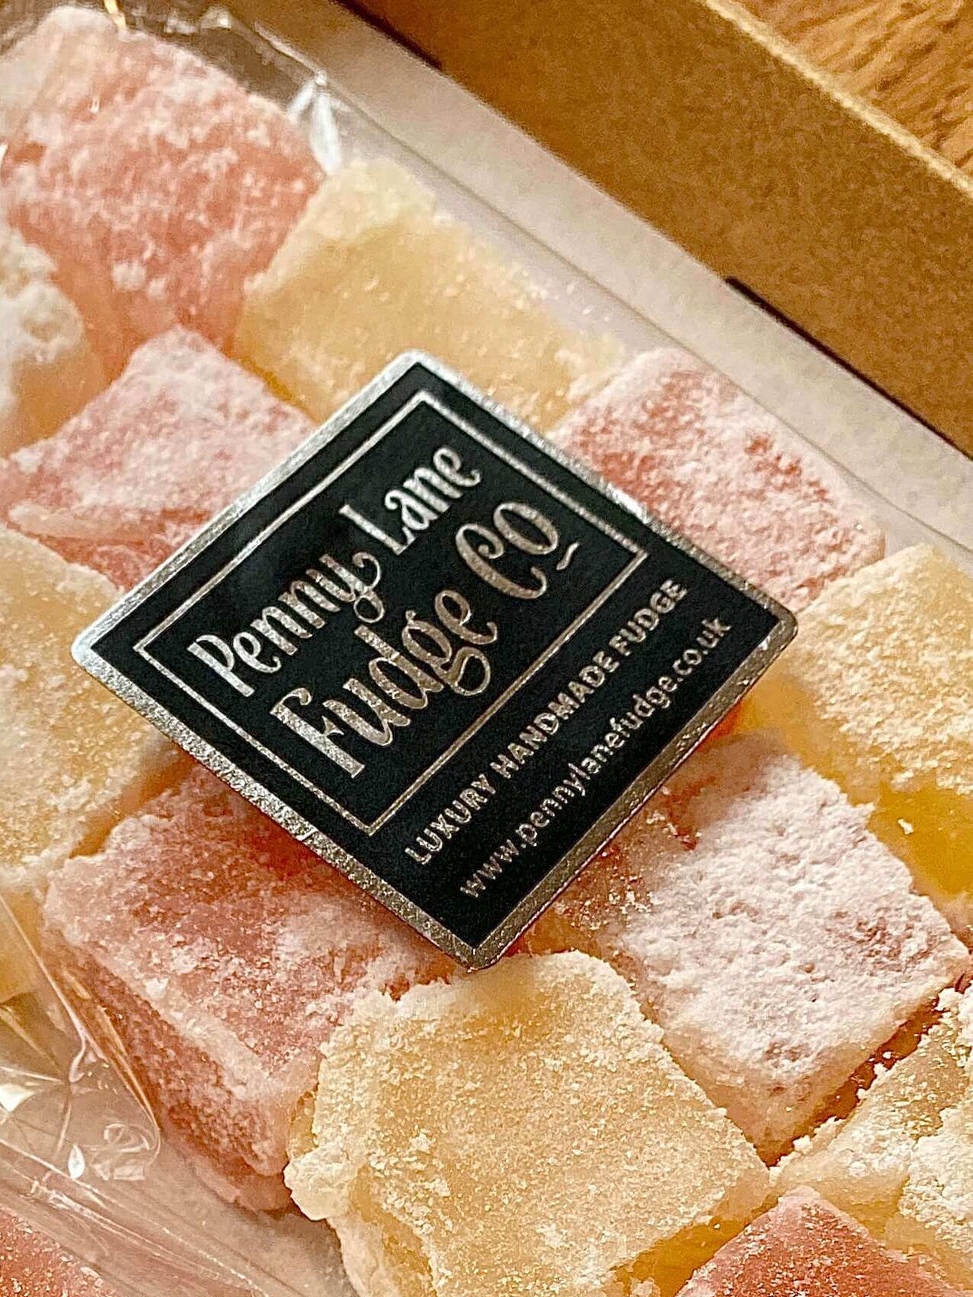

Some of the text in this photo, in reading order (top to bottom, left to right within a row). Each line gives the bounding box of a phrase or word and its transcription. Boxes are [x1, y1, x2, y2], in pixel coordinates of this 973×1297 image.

[187, 447, 481, 697] Penny Lane
[269, 590, 498, 779] Fudge
[405, 579, 688, 864] LUXURY HANDMADE FUDGE
[460, 618, 731, 898] www.pennylanefudge.co.uk
